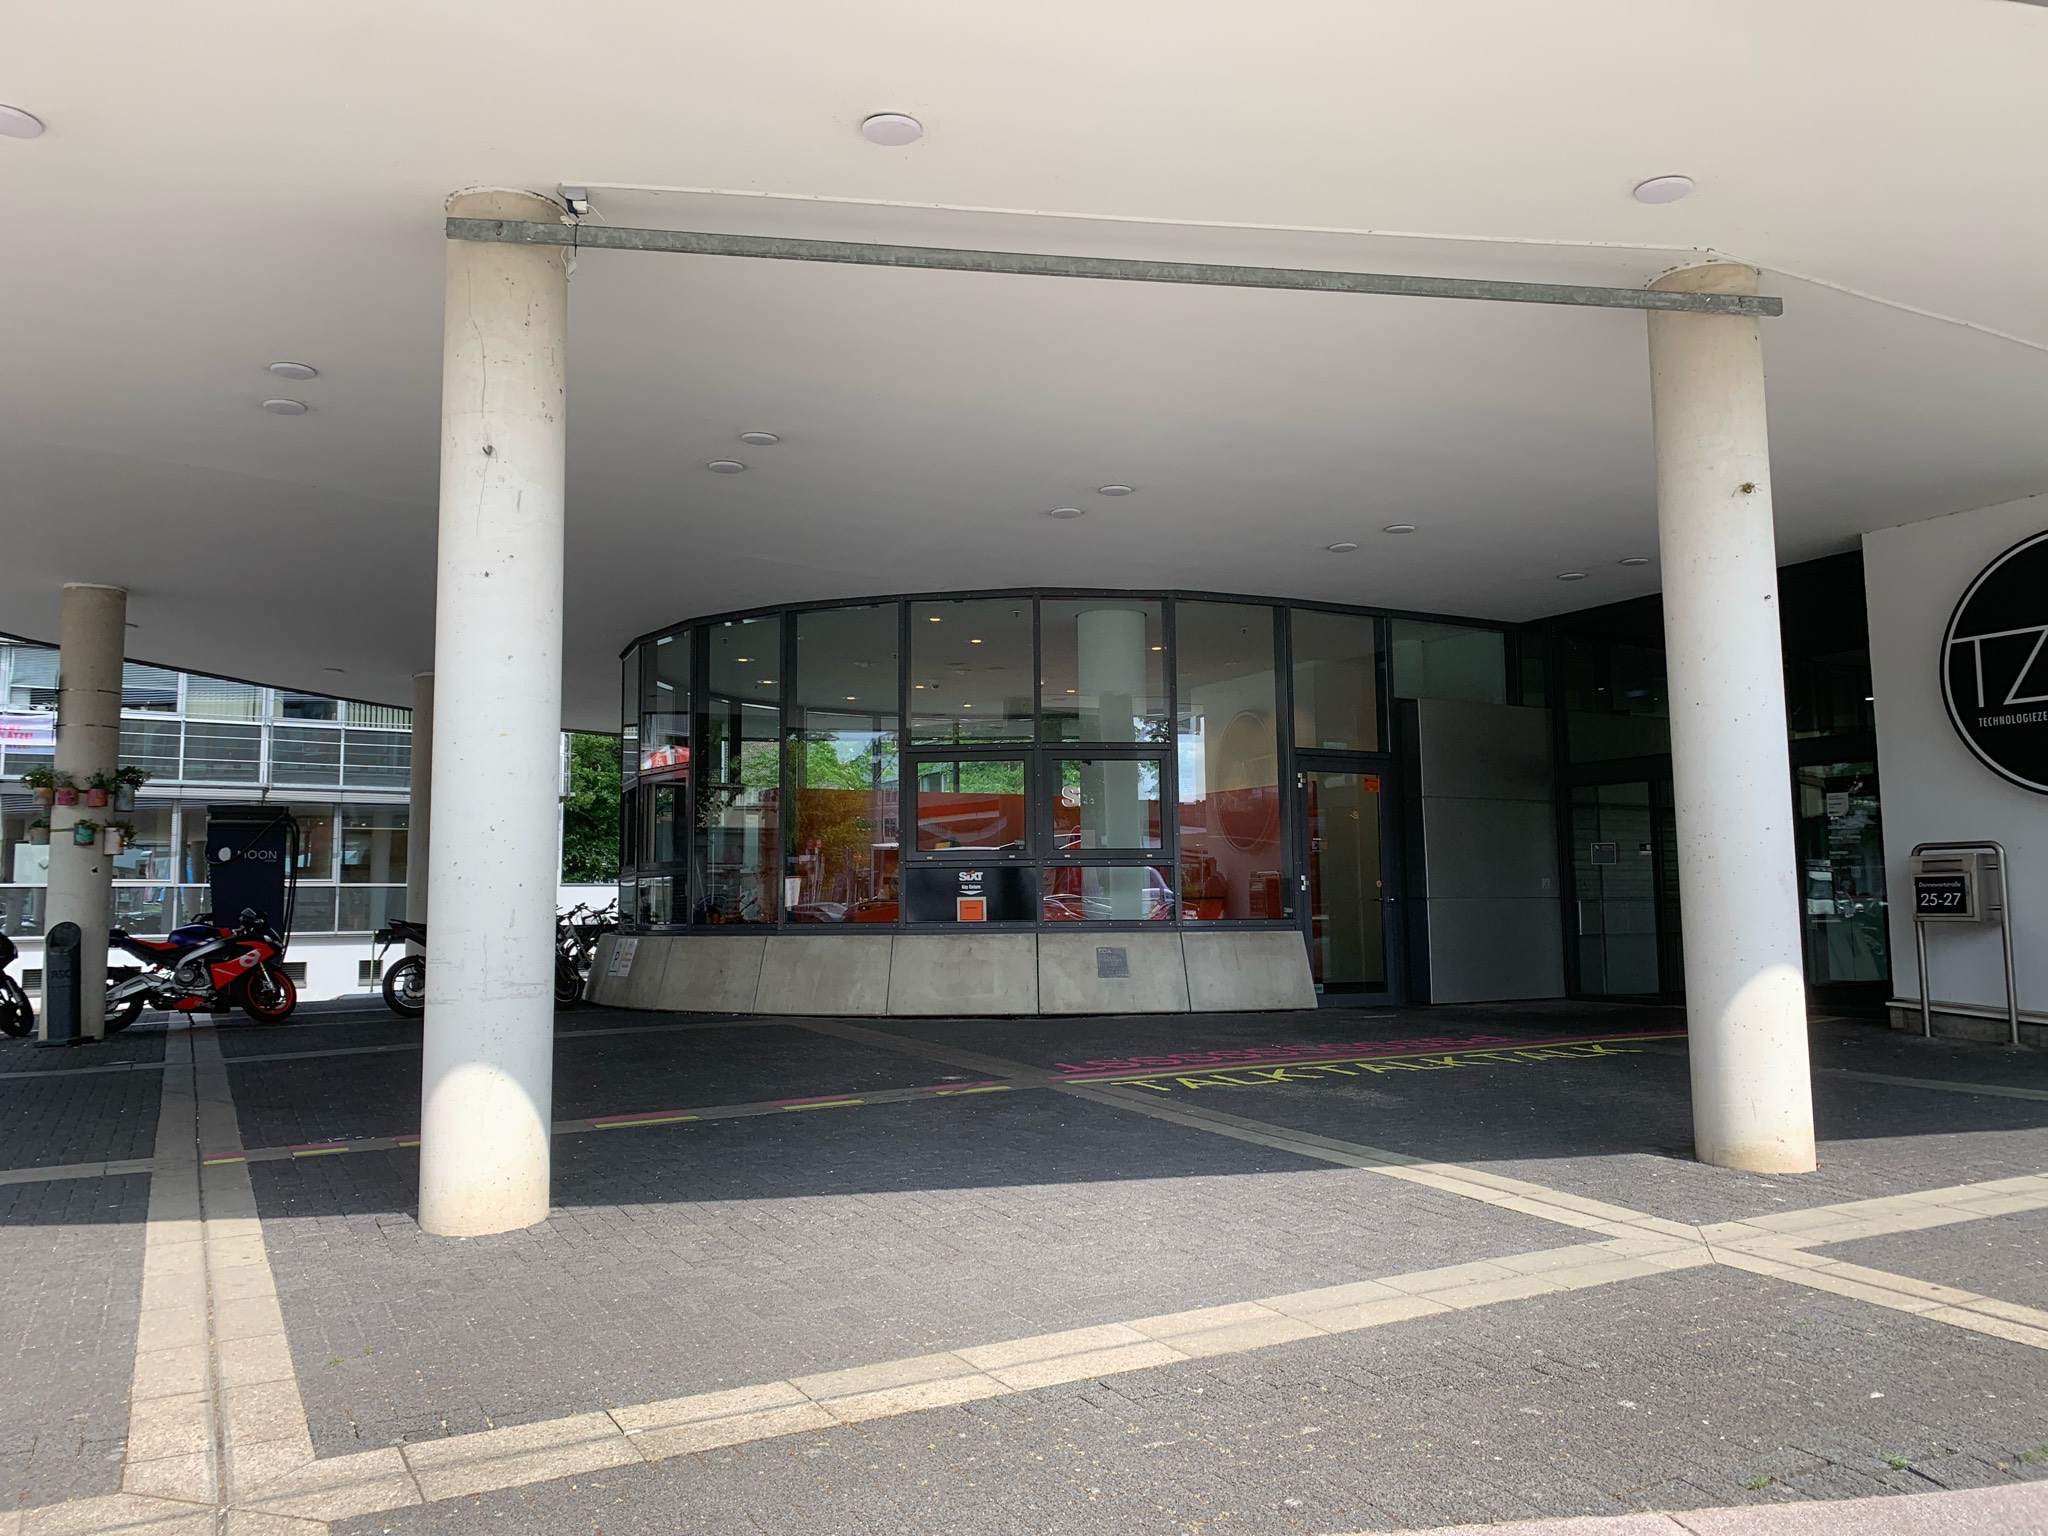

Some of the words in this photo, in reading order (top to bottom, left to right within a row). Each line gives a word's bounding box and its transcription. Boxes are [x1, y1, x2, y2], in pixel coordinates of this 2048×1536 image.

[1977, 710, 2048, 728] TECHNOLOGIEZE
[958, 869, 984, 882] SIXT
[1920, 892, 1962, 906] 25-27
